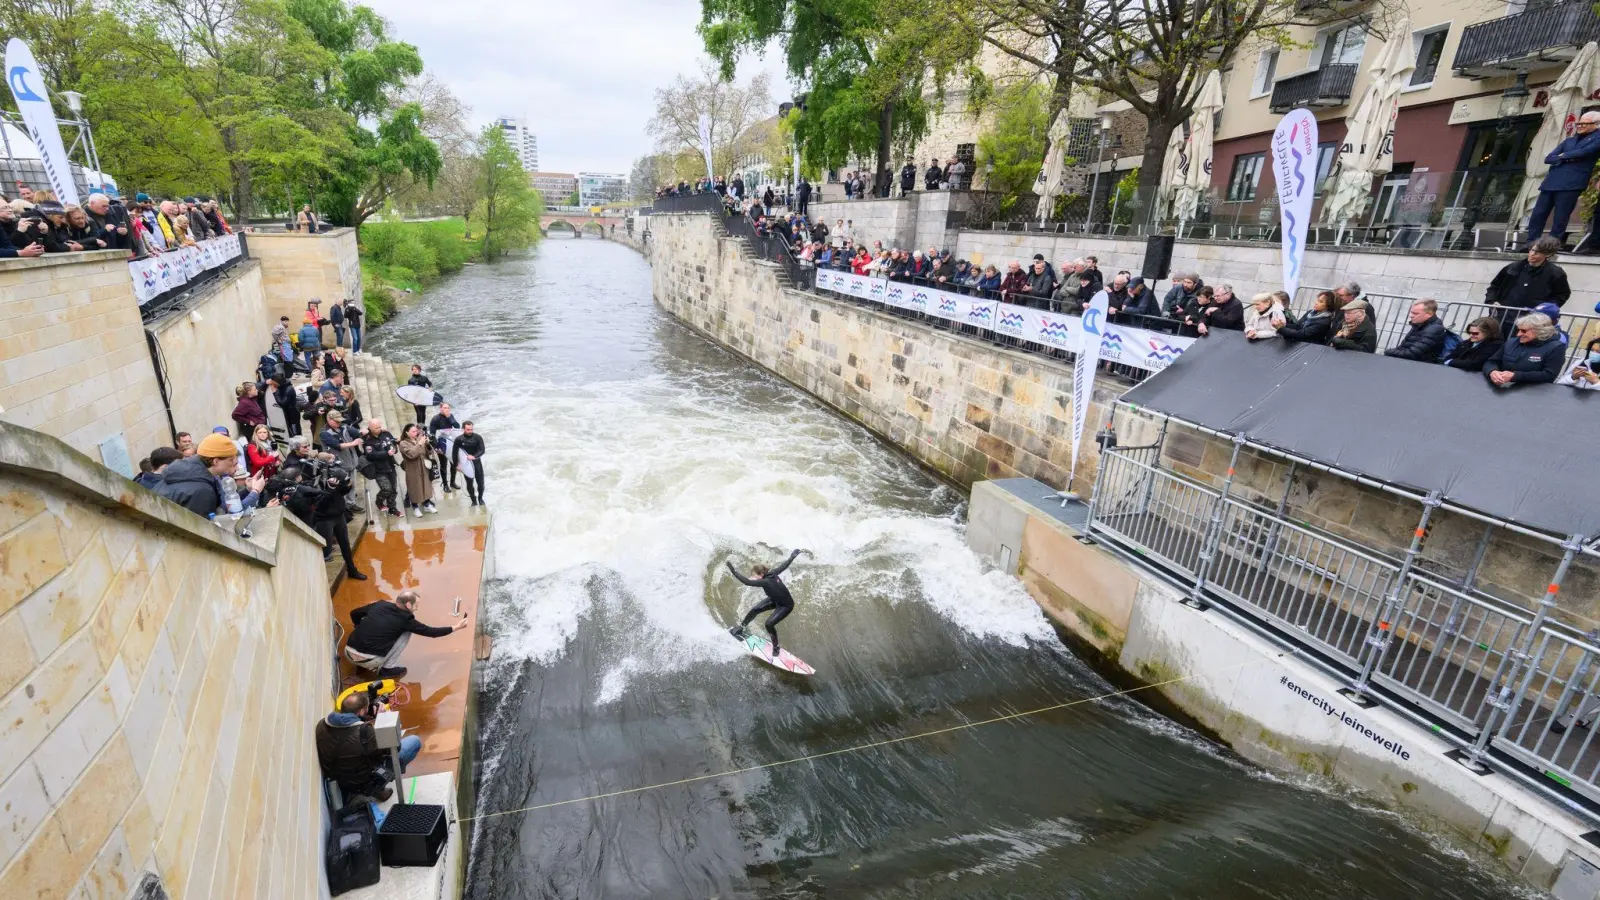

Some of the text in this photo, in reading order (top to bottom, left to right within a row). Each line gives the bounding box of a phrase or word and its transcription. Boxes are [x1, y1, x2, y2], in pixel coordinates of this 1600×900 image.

[1038, 334, 1068, 347] LEINEWELLE
[1099, 348, 1122, 360] EWELLE
[1144, 358, 1169, 370] LEINEW
[1280, 675, 1411, 761] #enercity-leinewelle
